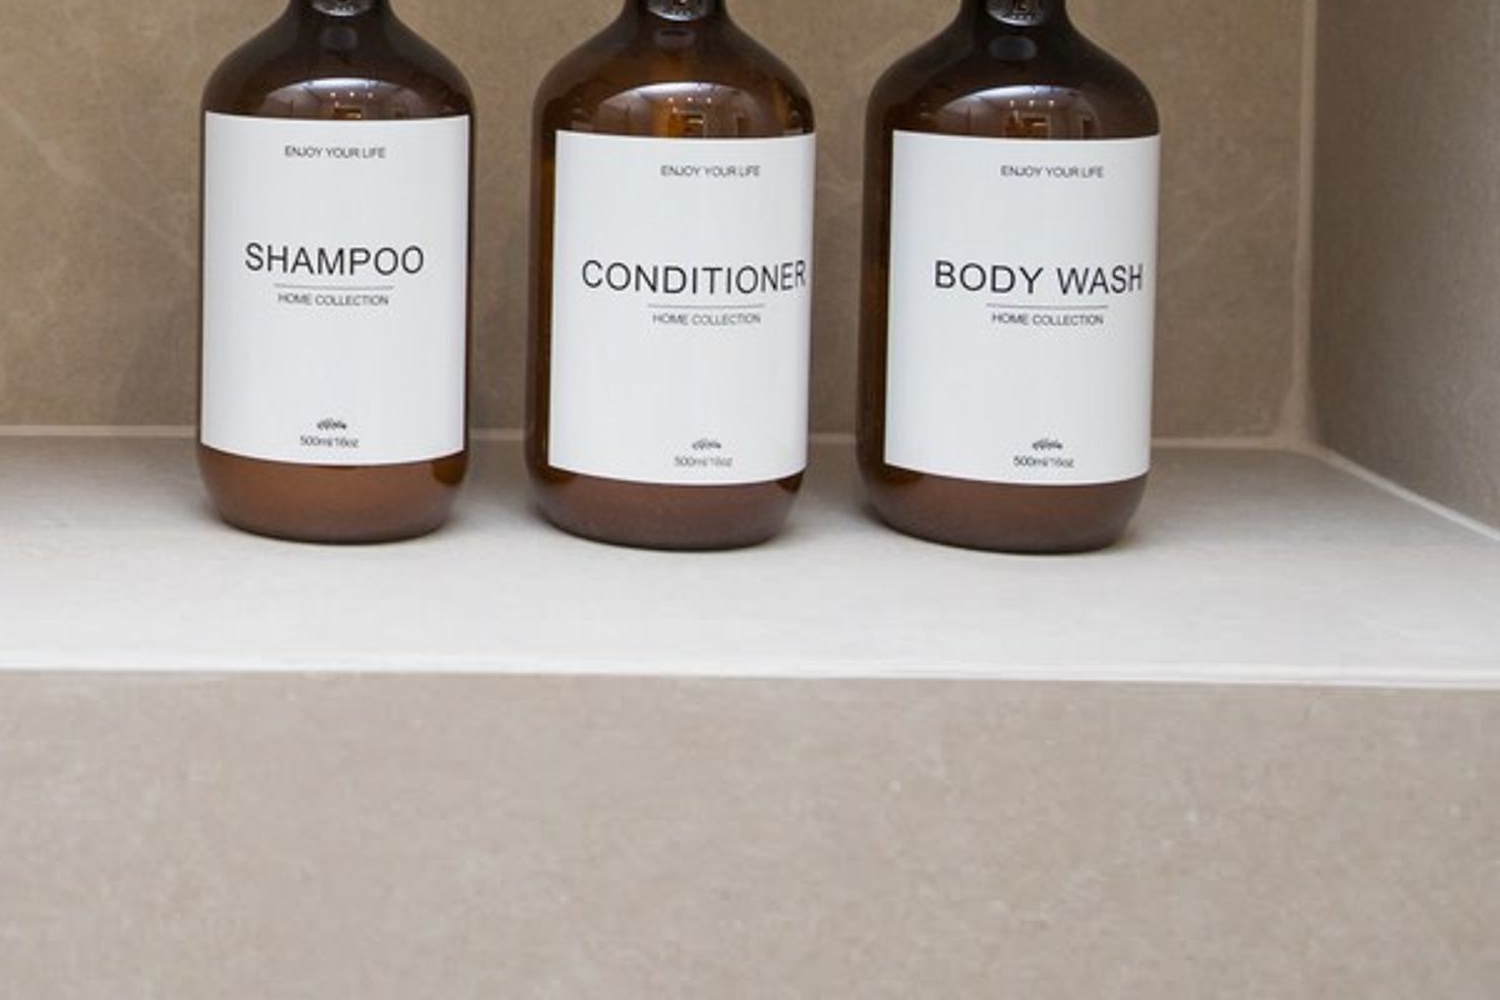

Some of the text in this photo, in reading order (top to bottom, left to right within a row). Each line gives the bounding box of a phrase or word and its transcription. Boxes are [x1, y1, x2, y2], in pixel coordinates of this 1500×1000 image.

[284, 144, 387, 159] ENJOY YOUR LIFE
[660, 164, 760, 178] ENJOY YOUR LIFE
[1000, 164, 1104, 178] ENJOY YOUR LIFE
[244, 241, 424, 276] SHAMPOO
[581, 259, 806, 295] CONDITIONER
[934, 259, 1143, 295] BODY WASH
[277, 292, 389, 306] HOME COLLECTION
[652, 312, 762, 326] HOME COLLECTION
[991, 312, 1104, 326] HOME COLLECTION
